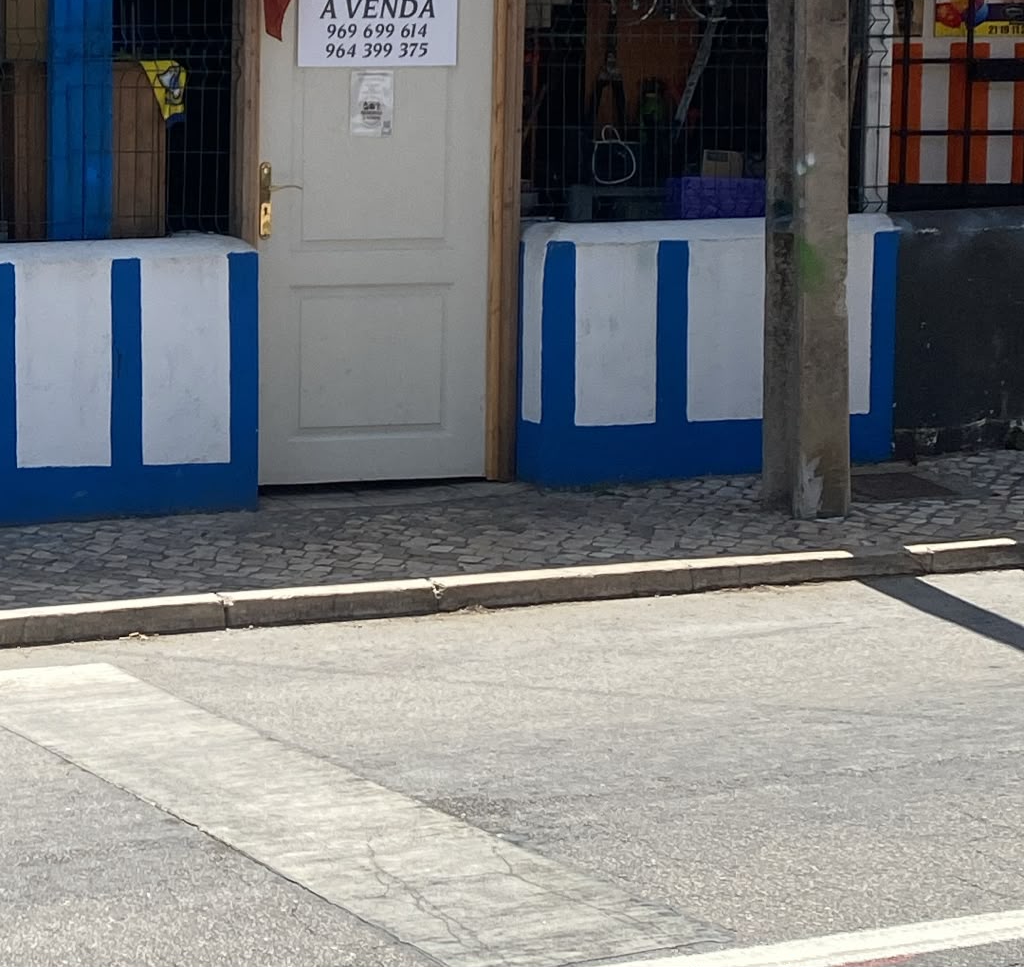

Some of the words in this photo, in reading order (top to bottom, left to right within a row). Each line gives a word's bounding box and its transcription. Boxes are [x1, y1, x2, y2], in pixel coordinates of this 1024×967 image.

[326, 23, 357, 39] 969
[363, 23, 395, 39] 699
[400, 23, 427, 39] 614
[325, 43, 357, 58] 964
[362, 42, 393, 58] 399
[398, 42, 429, 58] 375
